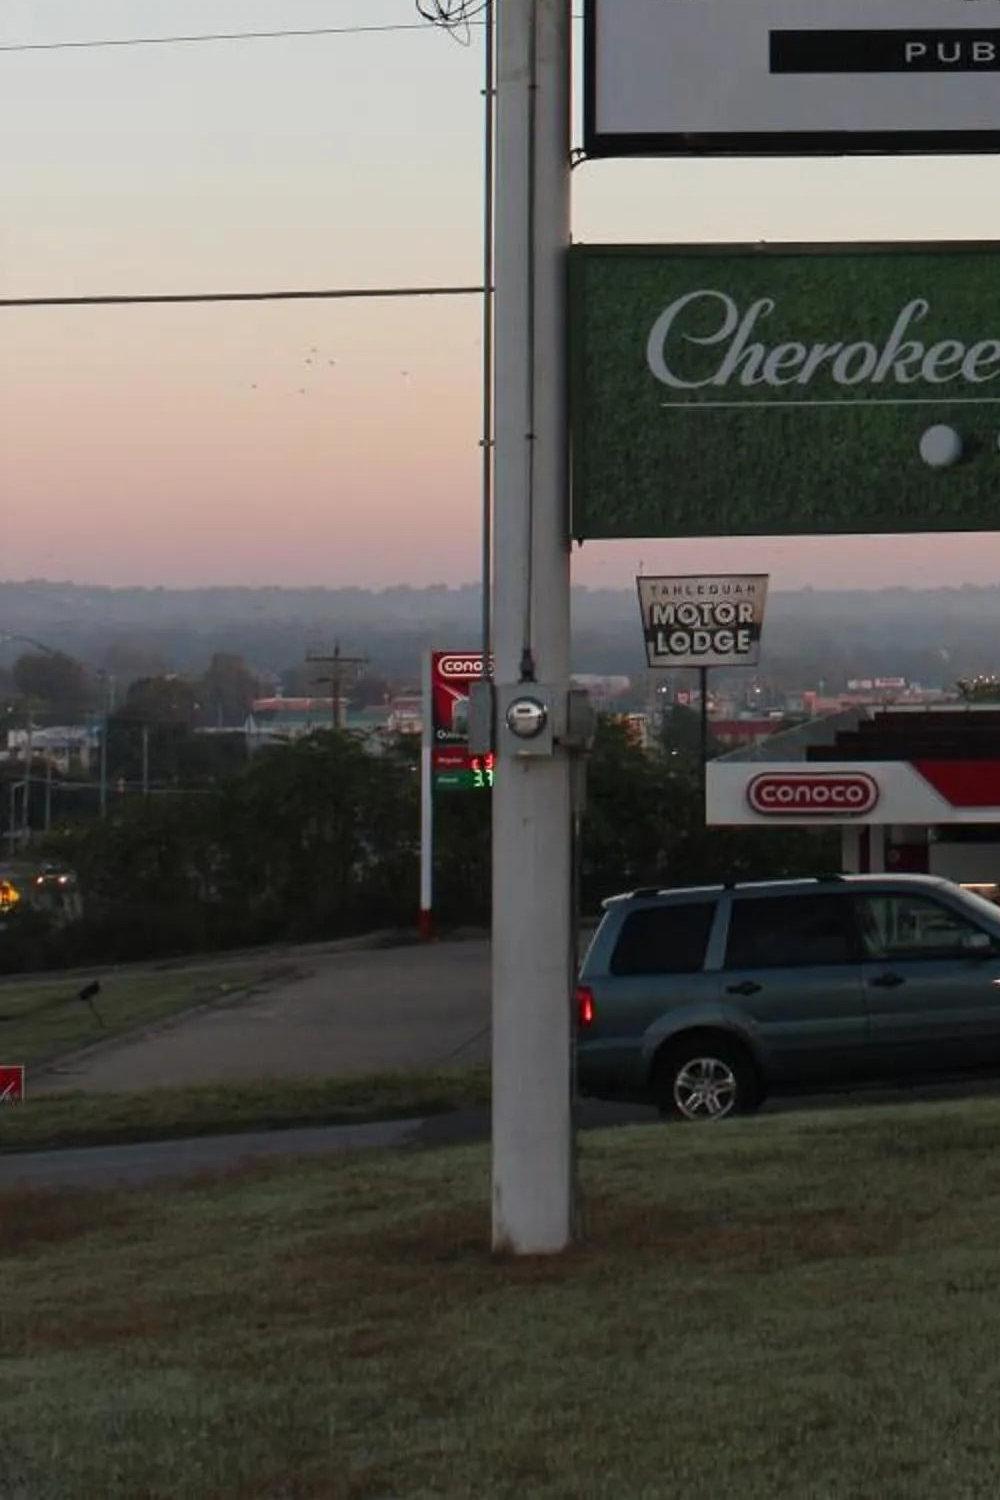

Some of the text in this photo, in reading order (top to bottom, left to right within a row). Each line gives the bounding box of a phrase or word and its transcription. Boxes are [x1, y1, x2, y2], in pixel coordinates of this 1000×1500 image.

[651, 601, 755, 626] MOTOR
[655, 628, 752, 654] LODGE
[760, 785, 864, 803] conoco
